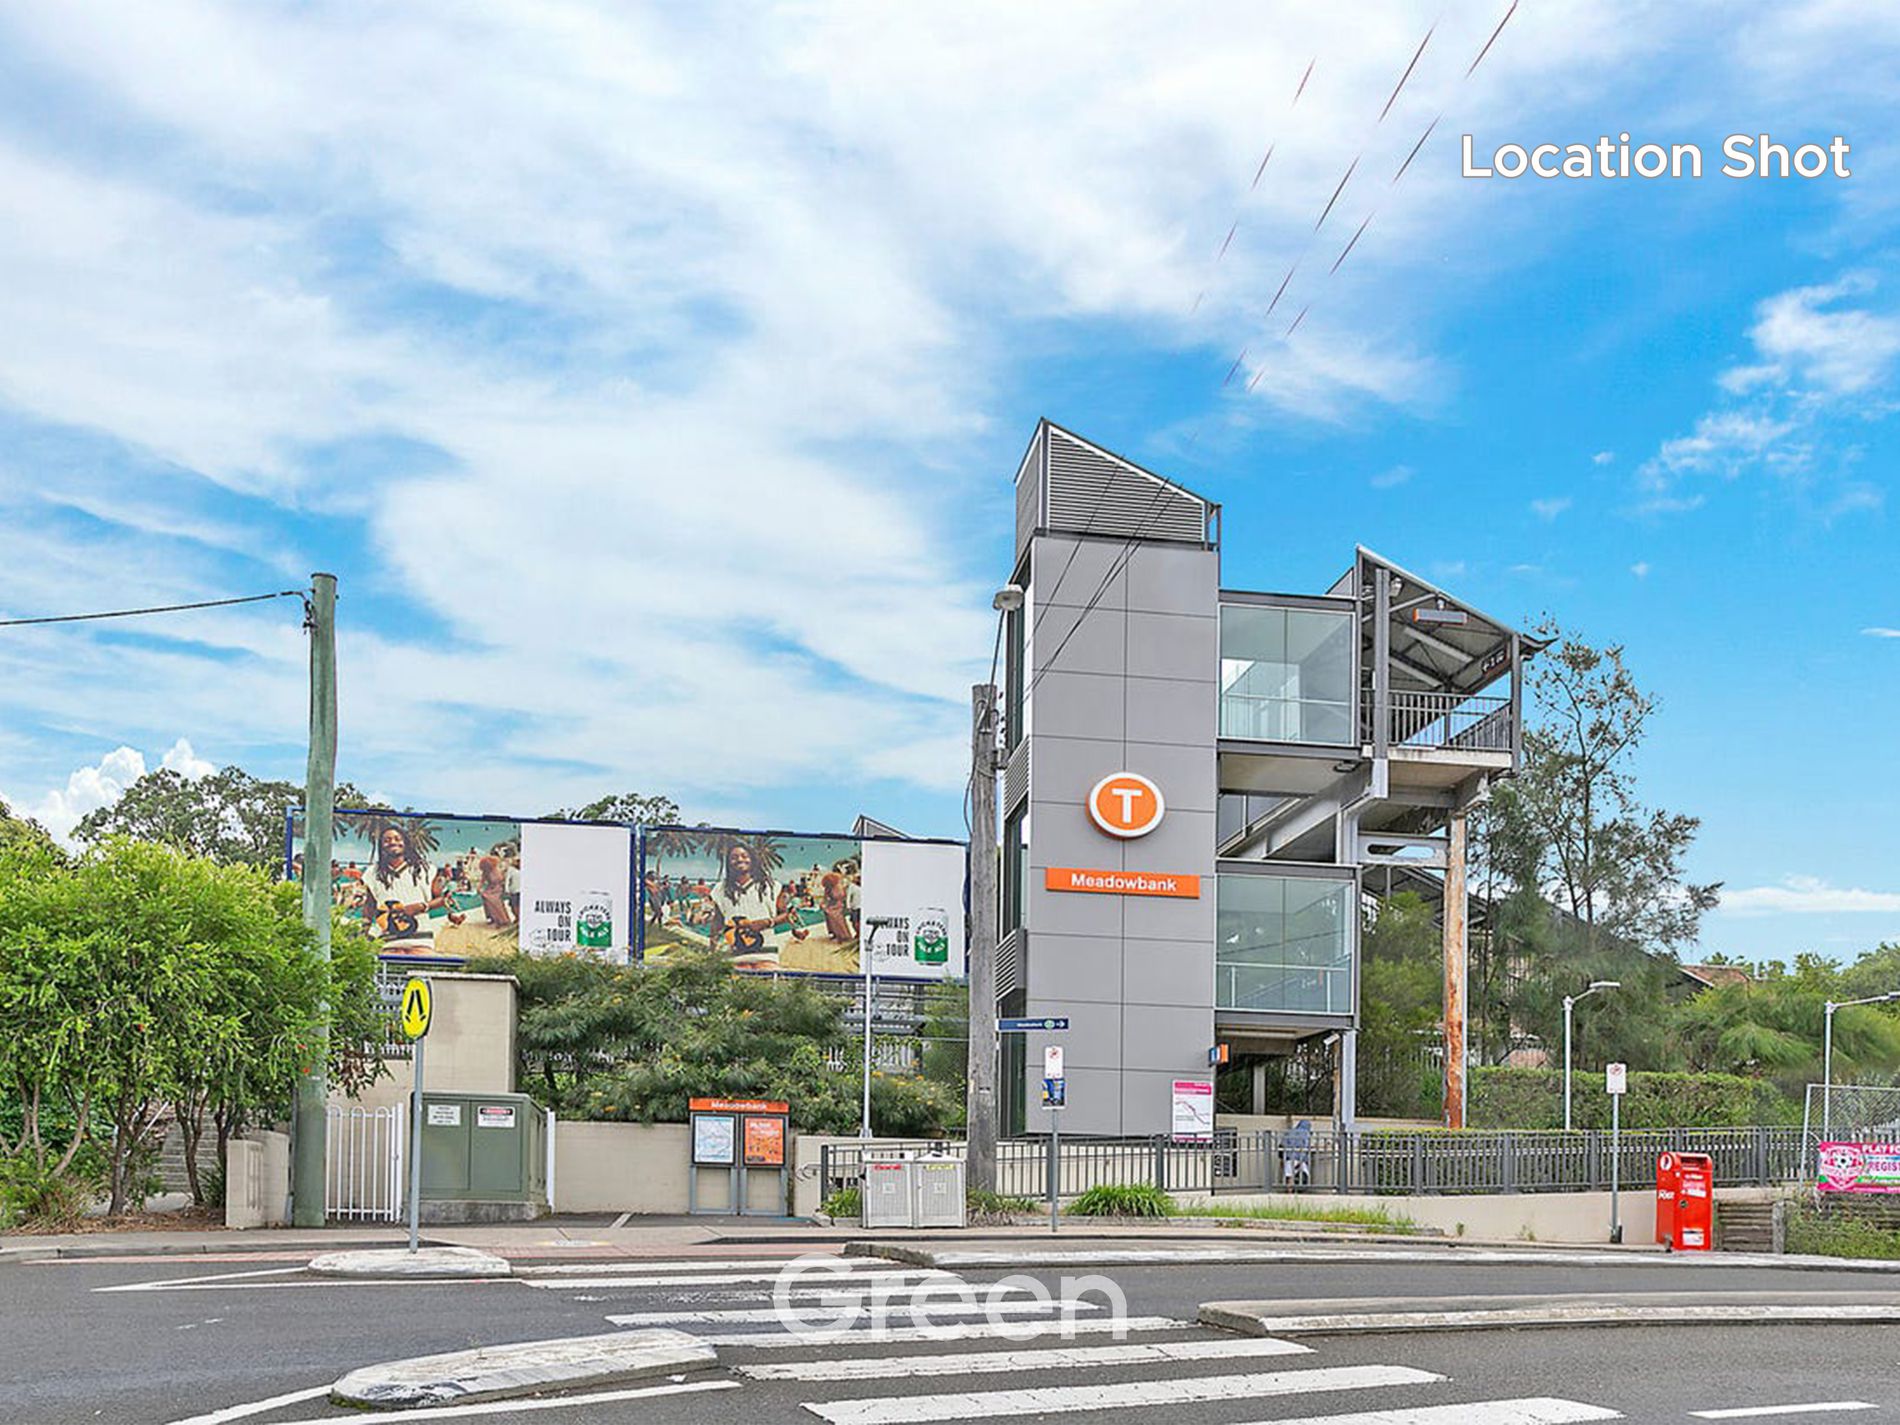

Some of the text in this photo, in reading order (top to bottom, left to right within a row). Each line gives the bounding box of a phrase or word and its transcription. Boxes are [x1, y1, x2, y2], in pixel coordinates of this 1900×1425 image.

[1111, 787, 1143, 823] T
[1071, 872, 1177, 892] Meadowbank
[534, 900, 571, 914] ALWAYS
[557, 914, 571, 928] ON
[546, 928, 571, 942] TOUR
[896, 930, 910, 943] ON
[886, 943, 910, 957] TOUR
[1862, 1144, 1887, 1155] PLAY
